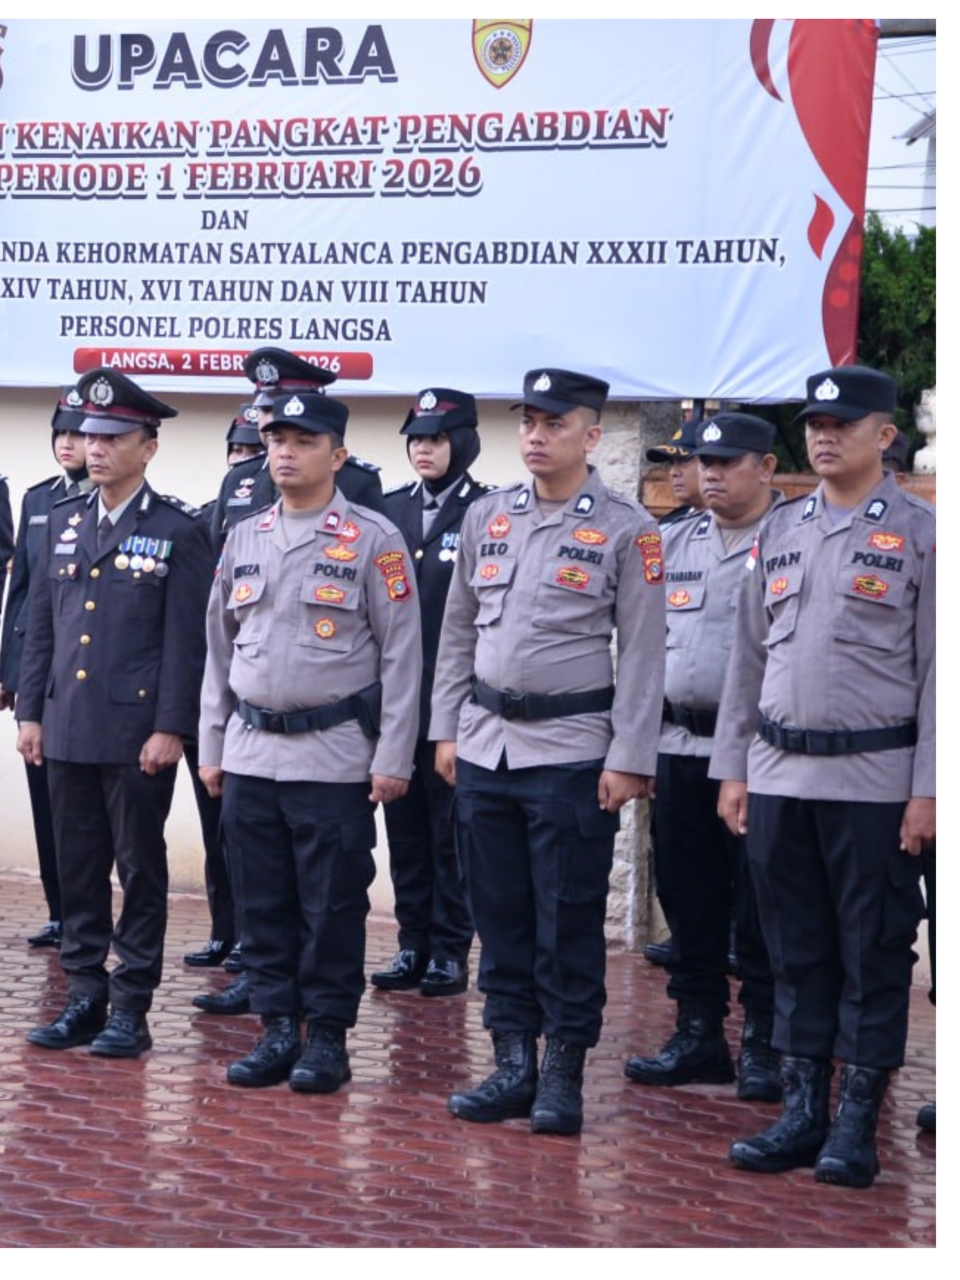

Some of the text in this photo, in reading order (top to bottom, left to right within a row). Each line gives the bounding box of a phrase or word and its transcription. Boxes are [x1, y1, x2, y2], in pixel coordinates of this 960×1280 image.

[72, 23, 398, 91] UPACARA
[12, 119, 201, 158] KENAIKAN
[207, 115, 389, 158] PANGKAT
[394, 107, 672, 154] PENGABDIAN
[156, 162, 177, 198] 1
[183, 160, 376, 199] FEBRUARI
[381, 156, 483, 197] 2026
[201, 210, 249, 231] DAN
[55, 242, 222, 265] KEHORMATAN
[228, 241, 393, 266] SATYALANCA
[400, 241, 579, 266] PENGABDIAN
[585, 241, 668, 265] XXXII
[676, 237, 786, 268] TAHUN,
[46, 278, 134, 305] TAHUN,
[140, 280, 182, 301] XVI
[190, 280, 273, 303] TAHUN
[280, 280, 334, 303] DAN
[341, 281, 388, 303] VIII
[396, 281, 488, 304] TAHUN
[60, 316, 392, 342] PERSONEL POLRES LANGSA
[100, 352, 175, 371] LANGSA,
[181, 353, 193, 369] 2
[299, 355, 341, 374] 026
[480, 542, 509, 558] EKO
[557, 545, 604, 566] POLRI
[852, 551, 905, 573] POLRI
[313, 562, 357, 582] POLRI
